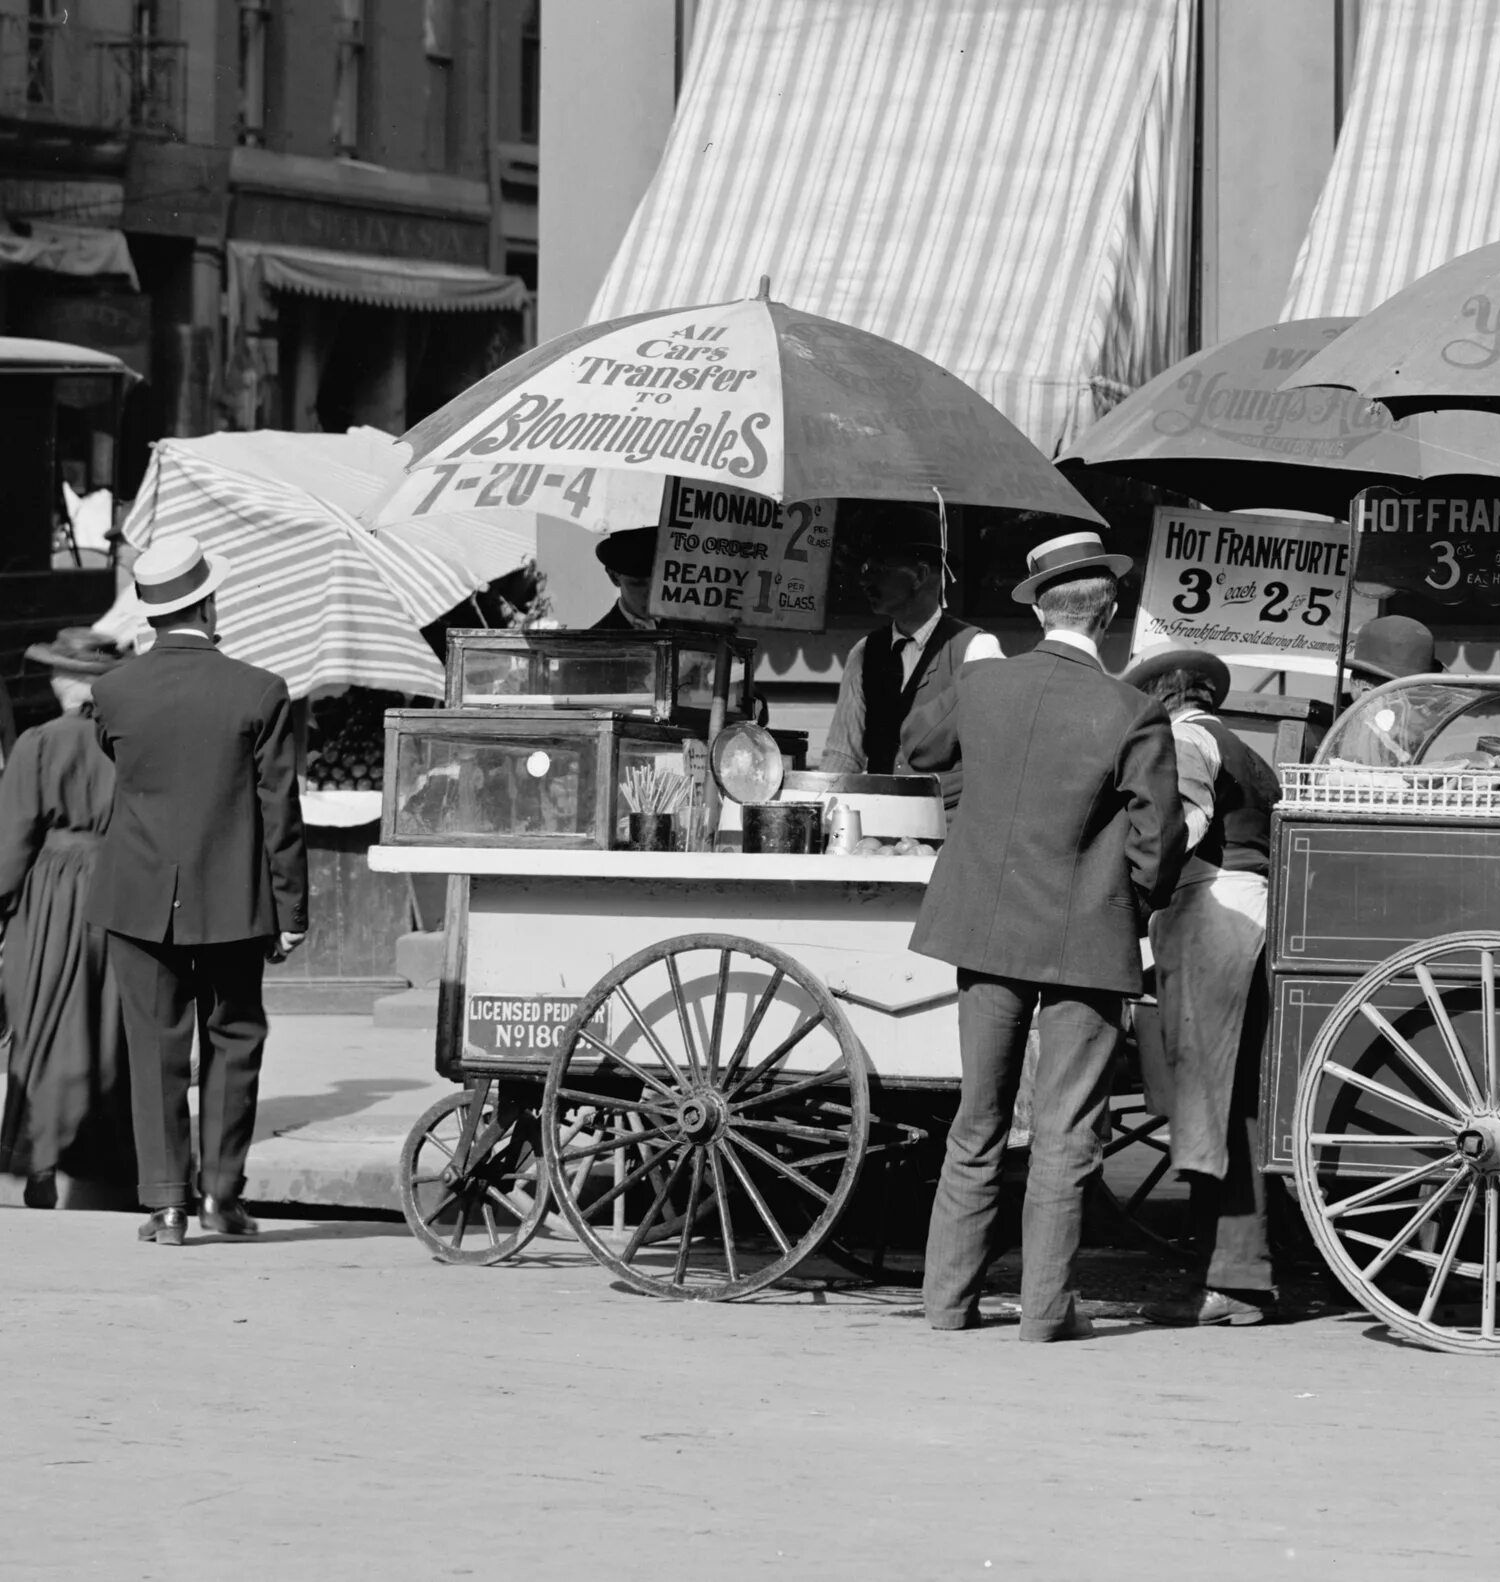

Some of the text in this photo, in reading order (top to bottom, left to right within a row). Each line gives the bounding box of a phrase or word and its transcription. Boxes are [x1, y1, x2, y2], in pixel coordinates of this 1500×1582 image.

[671, 324, 728, 342] All
[636, 339, 730, 362] Cars
[576, 355, 757, 393] Transfer
[635, 392, 673, 405] TO
[668, 476, 784, 530] LEMONADE
[703, 536, 769, 560] ORDER
[1165, 521, 1349, 577] HOT FRANKFURTE
[663, 560, 749, 587] READY
[1424, 540, 1461, 590] 3
[1466, 571, 1500, 586] EACH
[661, 585, 744, 610] MADE
[787, 582, 805, 592] PER
[1223, 581, 1257, 600] each
[1259, 581, 1290, 623] 2
[1145, 618, 1168, 634] No
[1168, 618, 1239, 644] Frankfurters
[1239, 630, 1260, 644] sold
[1260, 633, 1293, 651] during
[1291, 634, 1308, 648] the
[1307, 640, 1341, 652] summe
[470, 1000, 606, 1024] LICENSED PEDDR
